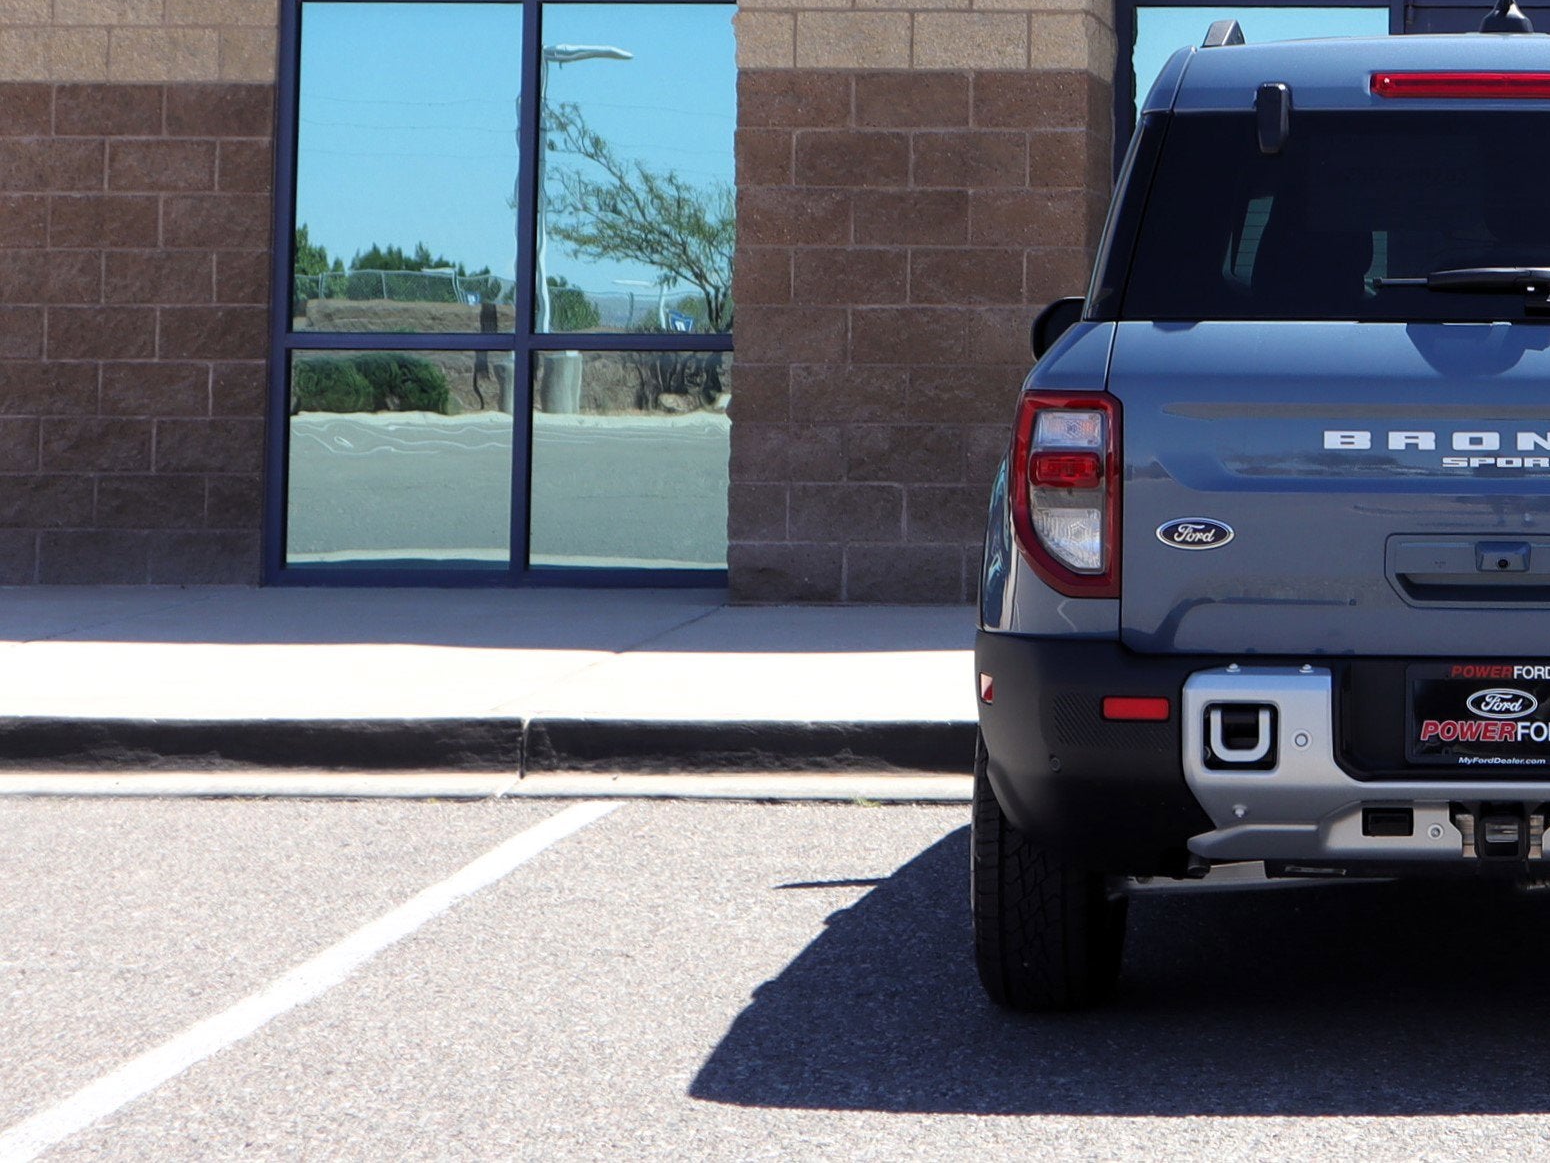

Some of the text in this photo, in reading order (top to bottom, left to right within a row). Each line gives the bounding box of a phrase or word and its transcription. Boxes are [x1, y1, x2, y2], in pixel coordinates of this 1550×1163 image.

[1173, 523, 1216, 542] Ford
[1480, 692, 1524, 712] Ford
[1458, 756, 1546, 766] MyFordDealer.com
